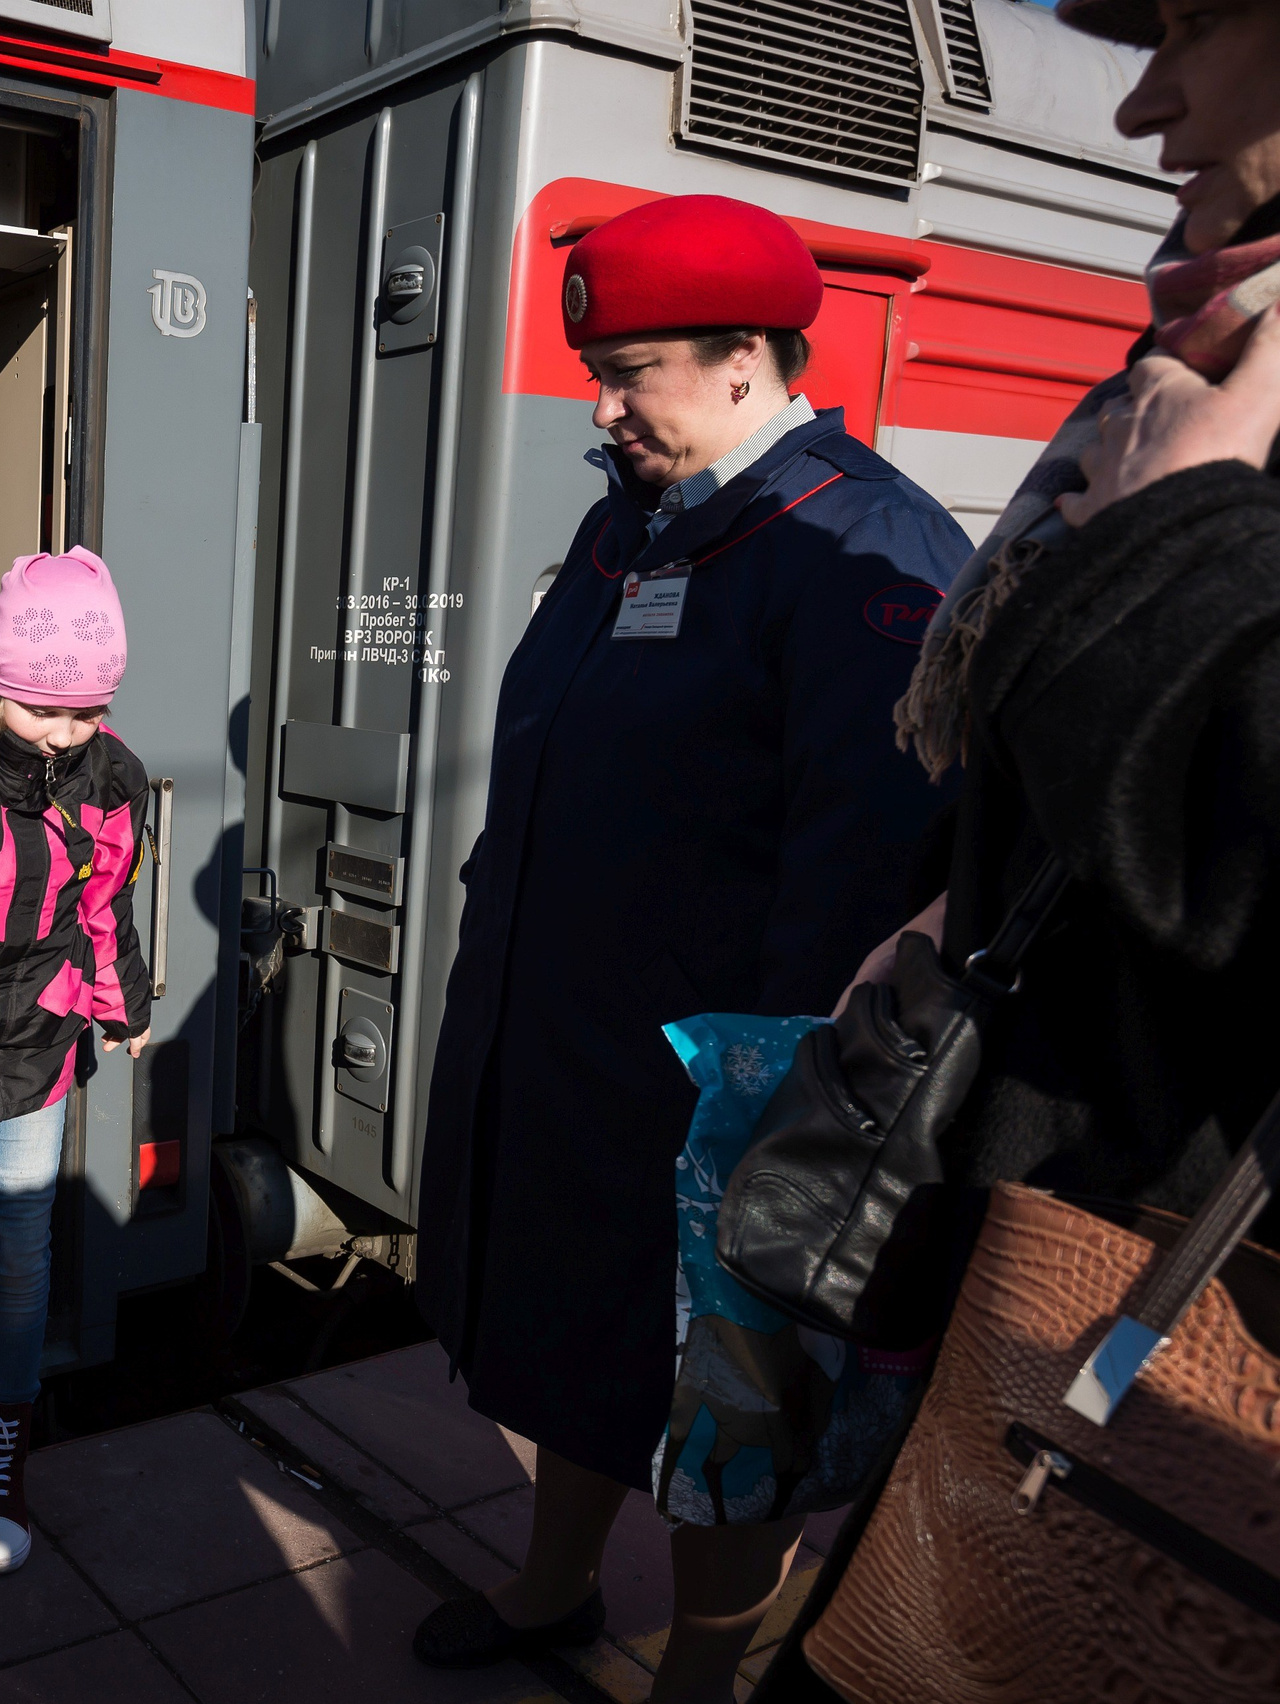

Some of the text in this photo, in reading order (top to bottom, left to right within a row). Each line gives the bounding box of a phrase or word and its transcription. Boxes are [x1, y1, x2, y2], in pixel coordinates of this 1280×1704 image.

[382, 576, 411, 592] КР-1
[359, 612, 406, 630] Пробег
[361, 647, 409, 665] ЛВЧД-3
[352, 1116, 378, 1139] 1045
